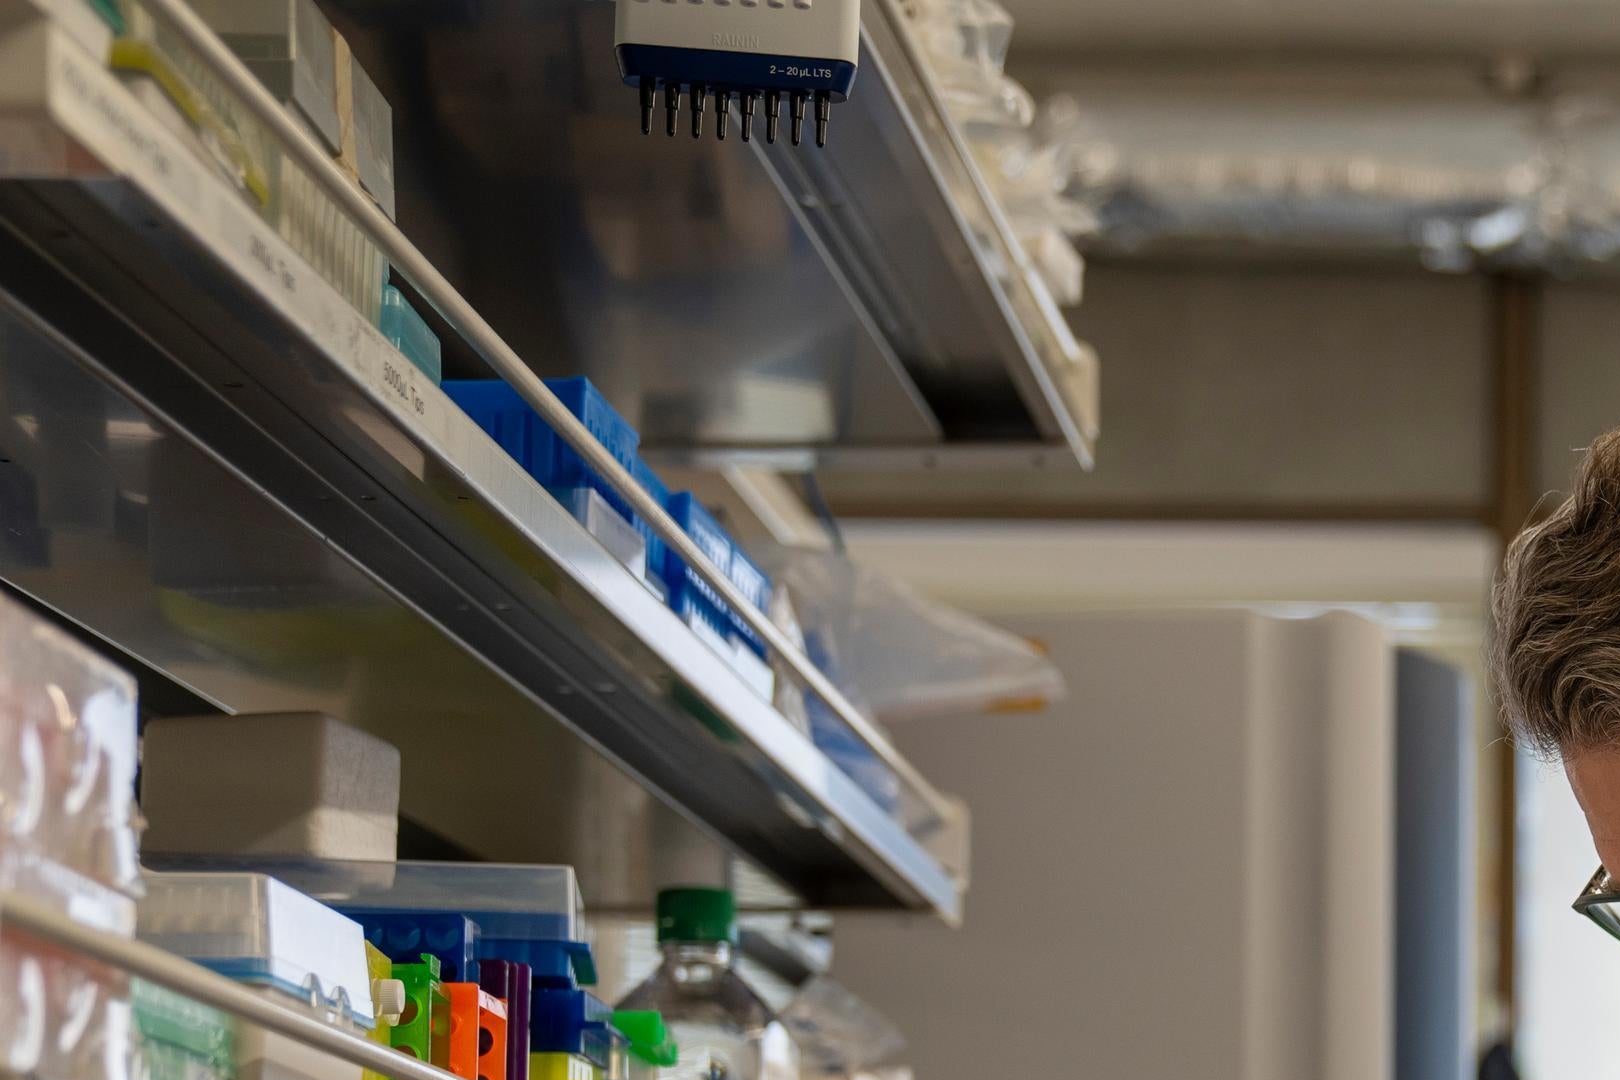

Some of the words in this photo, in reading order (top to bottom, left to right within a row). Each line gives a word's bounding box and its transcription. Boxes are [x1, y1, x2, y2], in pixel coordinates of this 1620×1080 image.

[712, 33, 760, 49] RAININ
[769, 65, 776, 74] 2
[786, 66, 799, 76] 20
[813, 68, 832, 78] LTS
